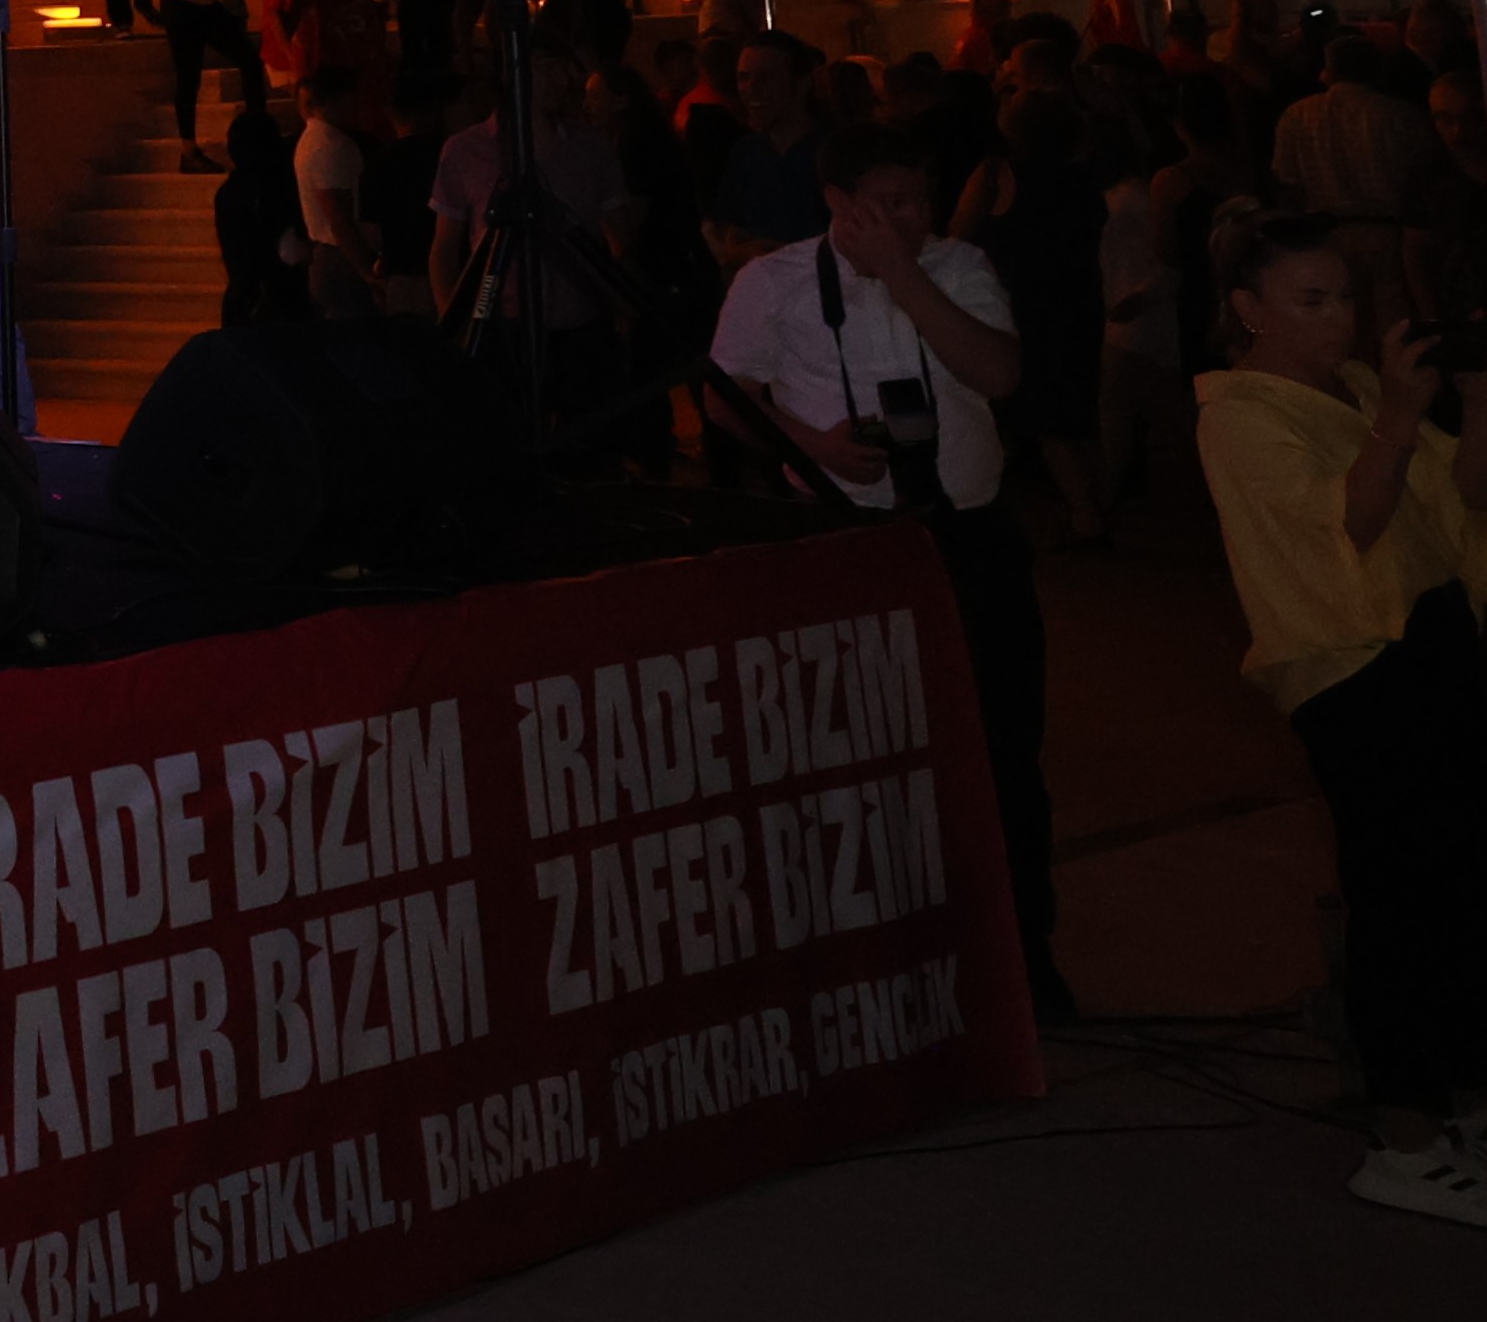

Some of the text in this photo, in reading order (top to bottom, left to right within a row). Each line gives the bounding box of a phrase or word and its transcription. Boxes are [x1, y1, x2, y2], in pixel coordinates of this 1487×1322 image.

[223, 698, 472, 913] BİZİM
[514, 608, 929, 840] İRADE BİZİM
[249, 879, 490, 1100] BİZİM
[535, 768, 947, 1016] ZAFER BİZİM
